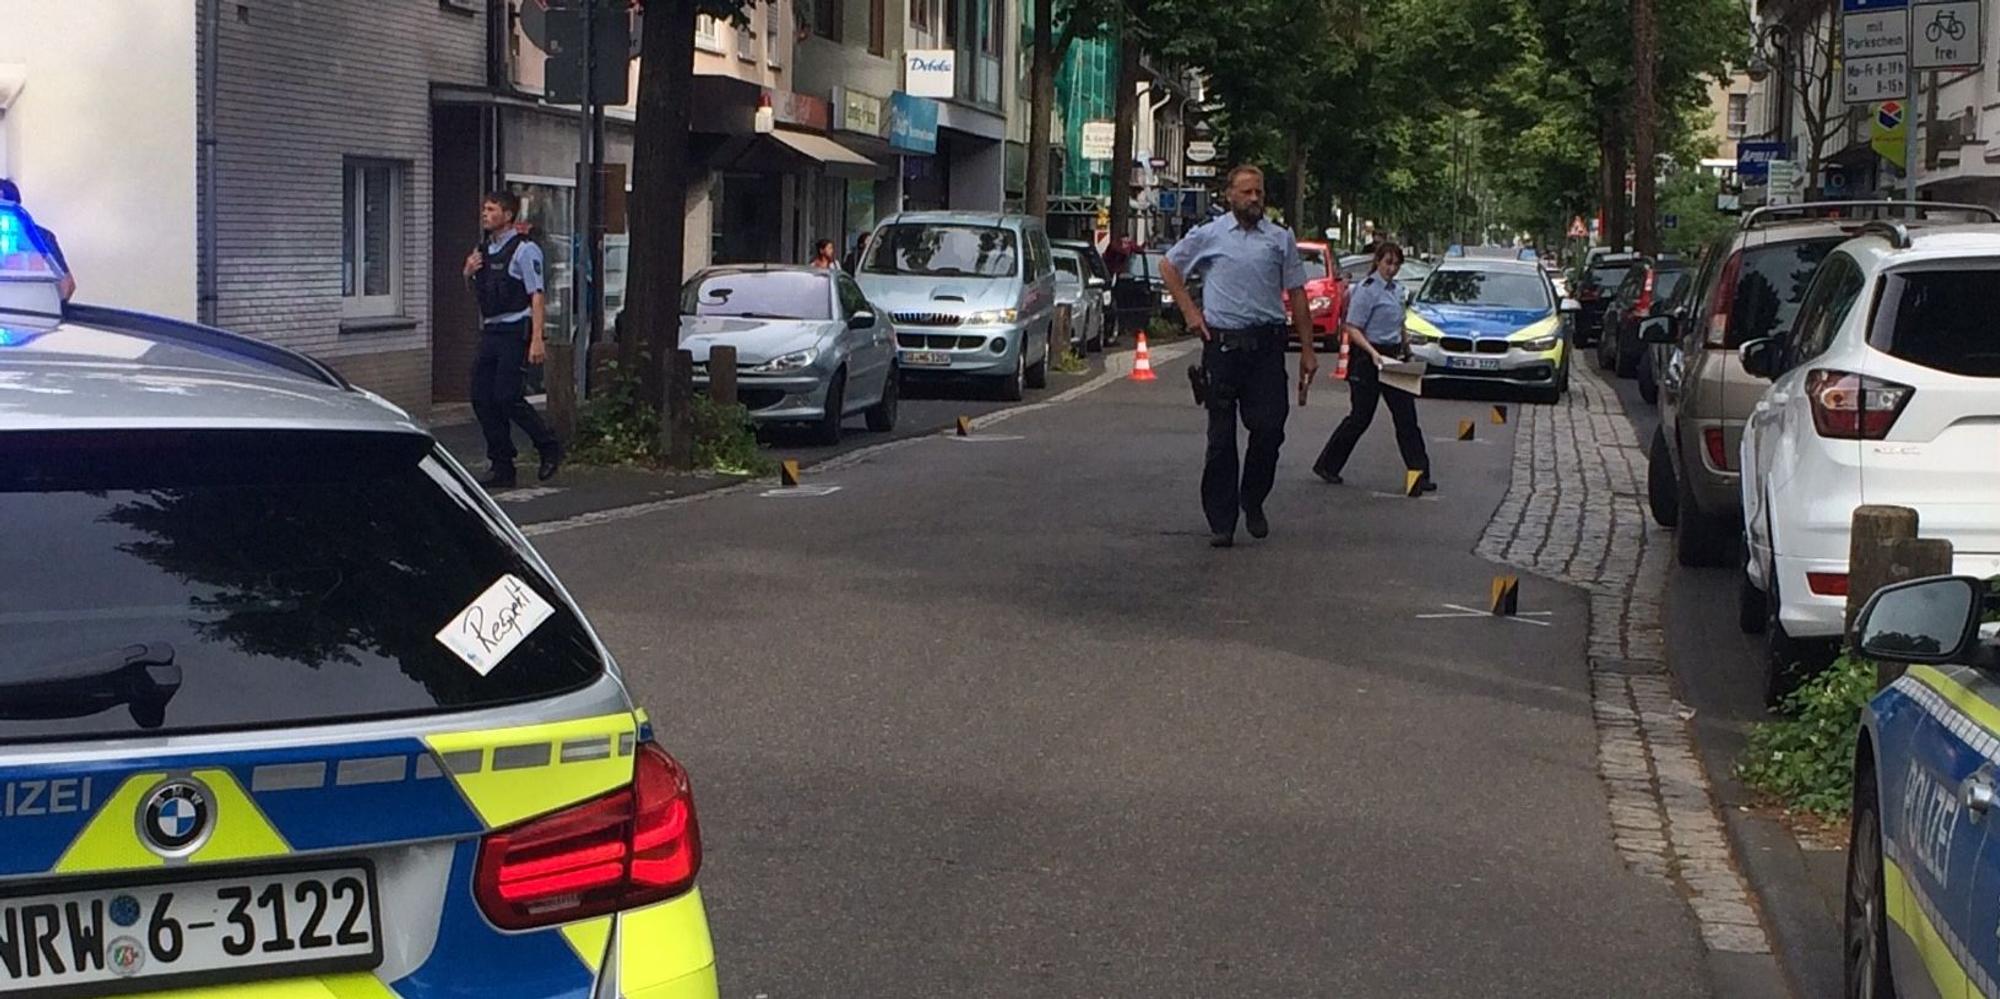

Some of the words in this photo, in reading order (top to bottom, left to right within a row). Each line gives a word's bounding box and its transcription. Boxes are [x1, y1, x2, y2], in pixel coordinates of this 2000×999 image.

[1866, 21, 1883, 32] mit
[1847, 35, 1903, 50] Parkschein
[1935, 46, 1957, 60] frei
[1847, 83, 1857, 96] Sa
[463, 577, 530, 654] Respekt
[0, 777, 92, 817] IZEI
[1902, 758, 1961, 889] POLIZEI
[148, 877, 369, 963] 6-3122
